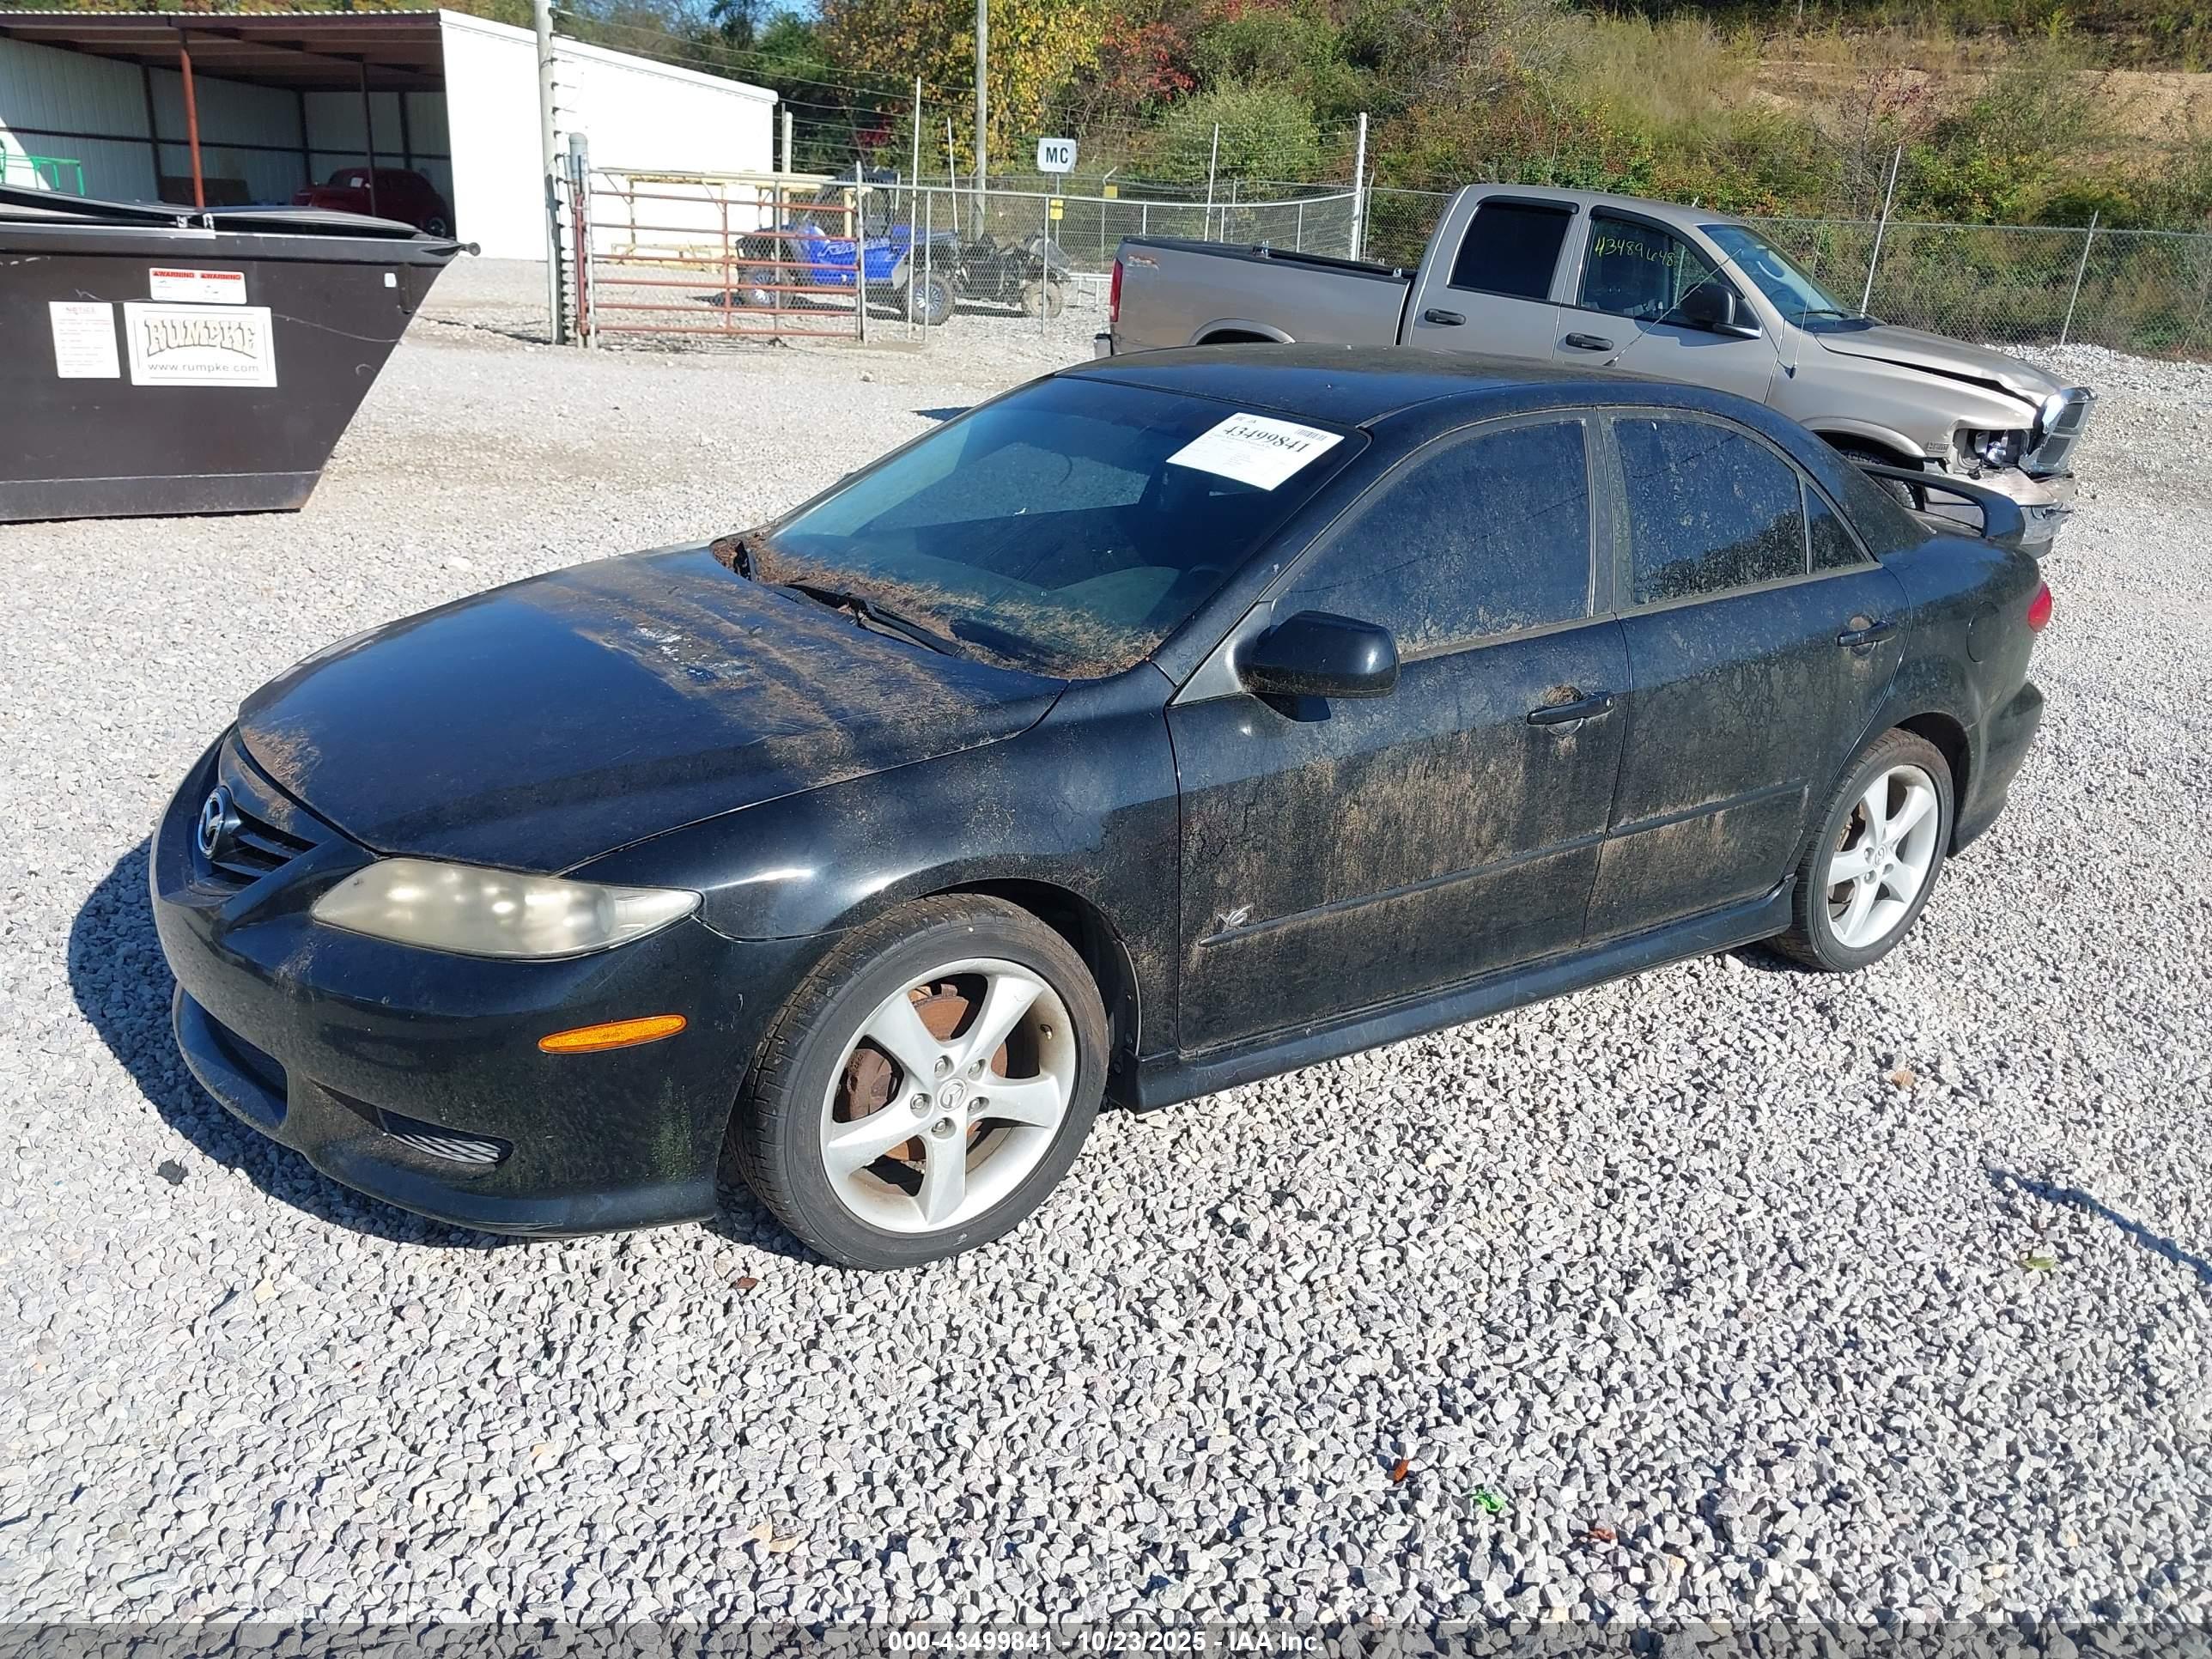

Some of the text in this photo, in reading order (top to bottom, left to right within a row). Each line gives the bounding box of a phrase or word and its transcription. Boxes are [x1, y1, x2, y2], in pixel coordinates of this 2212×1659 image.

[1045, 147, 1069, 164] MC
[1595, 236, 1675, 267] 43489648
[144, 319, 258, 359] RUMPKE
[148, 363, 259, 373] www.rumpke.com
[1223, 425, 1312, 453] 43499841
